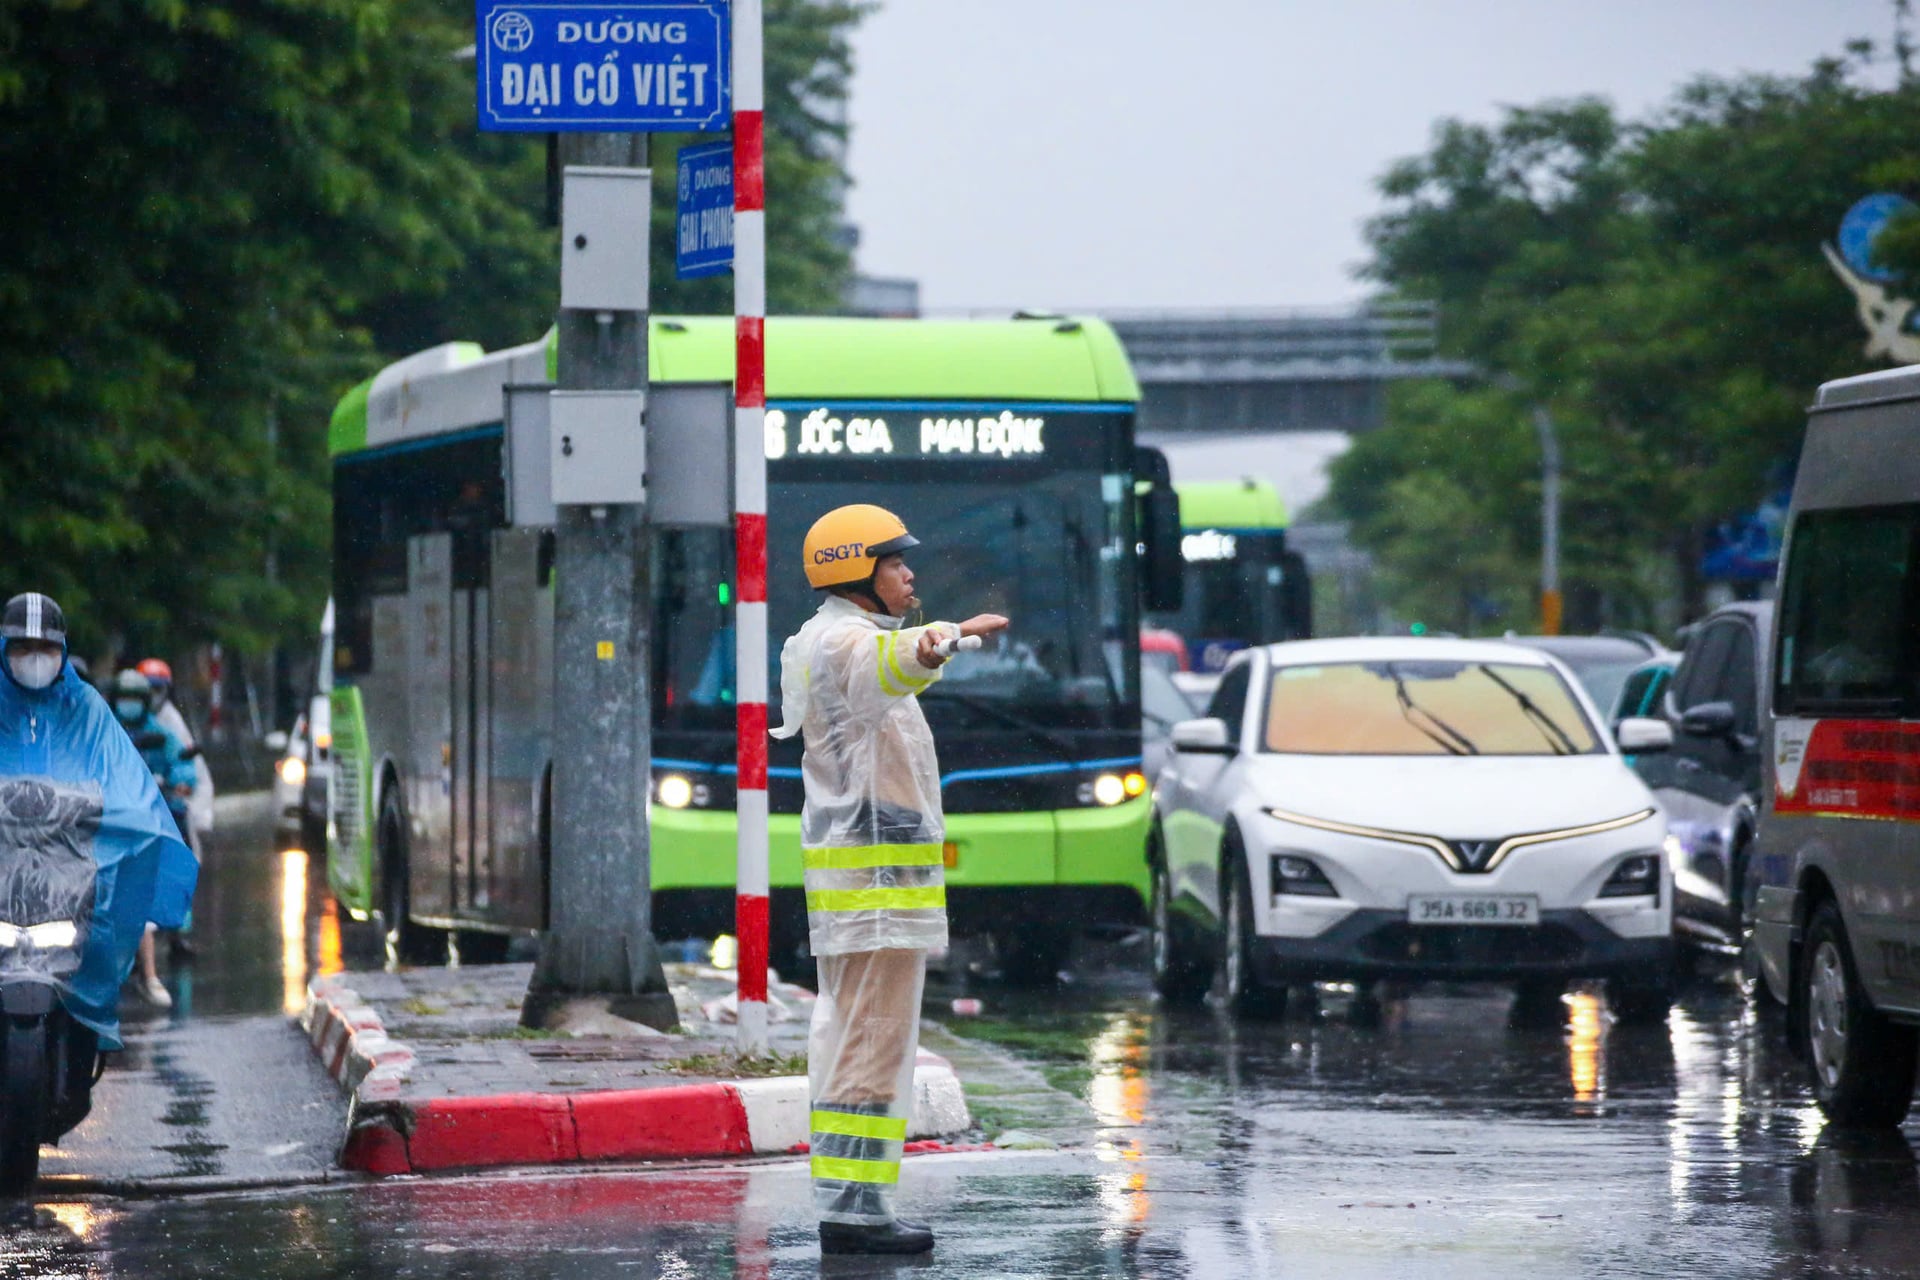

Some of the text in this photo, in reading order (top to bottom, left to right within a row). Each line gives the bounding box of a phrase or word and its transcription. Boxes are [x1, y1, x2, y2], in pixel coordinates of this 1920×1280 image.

[501, 63, 561, 115] ĐẠI
[632, 53, 708, 116] VIỆT
[920, 418, 974, 454] MAI
[814, 542, 864, 565] CSGT
